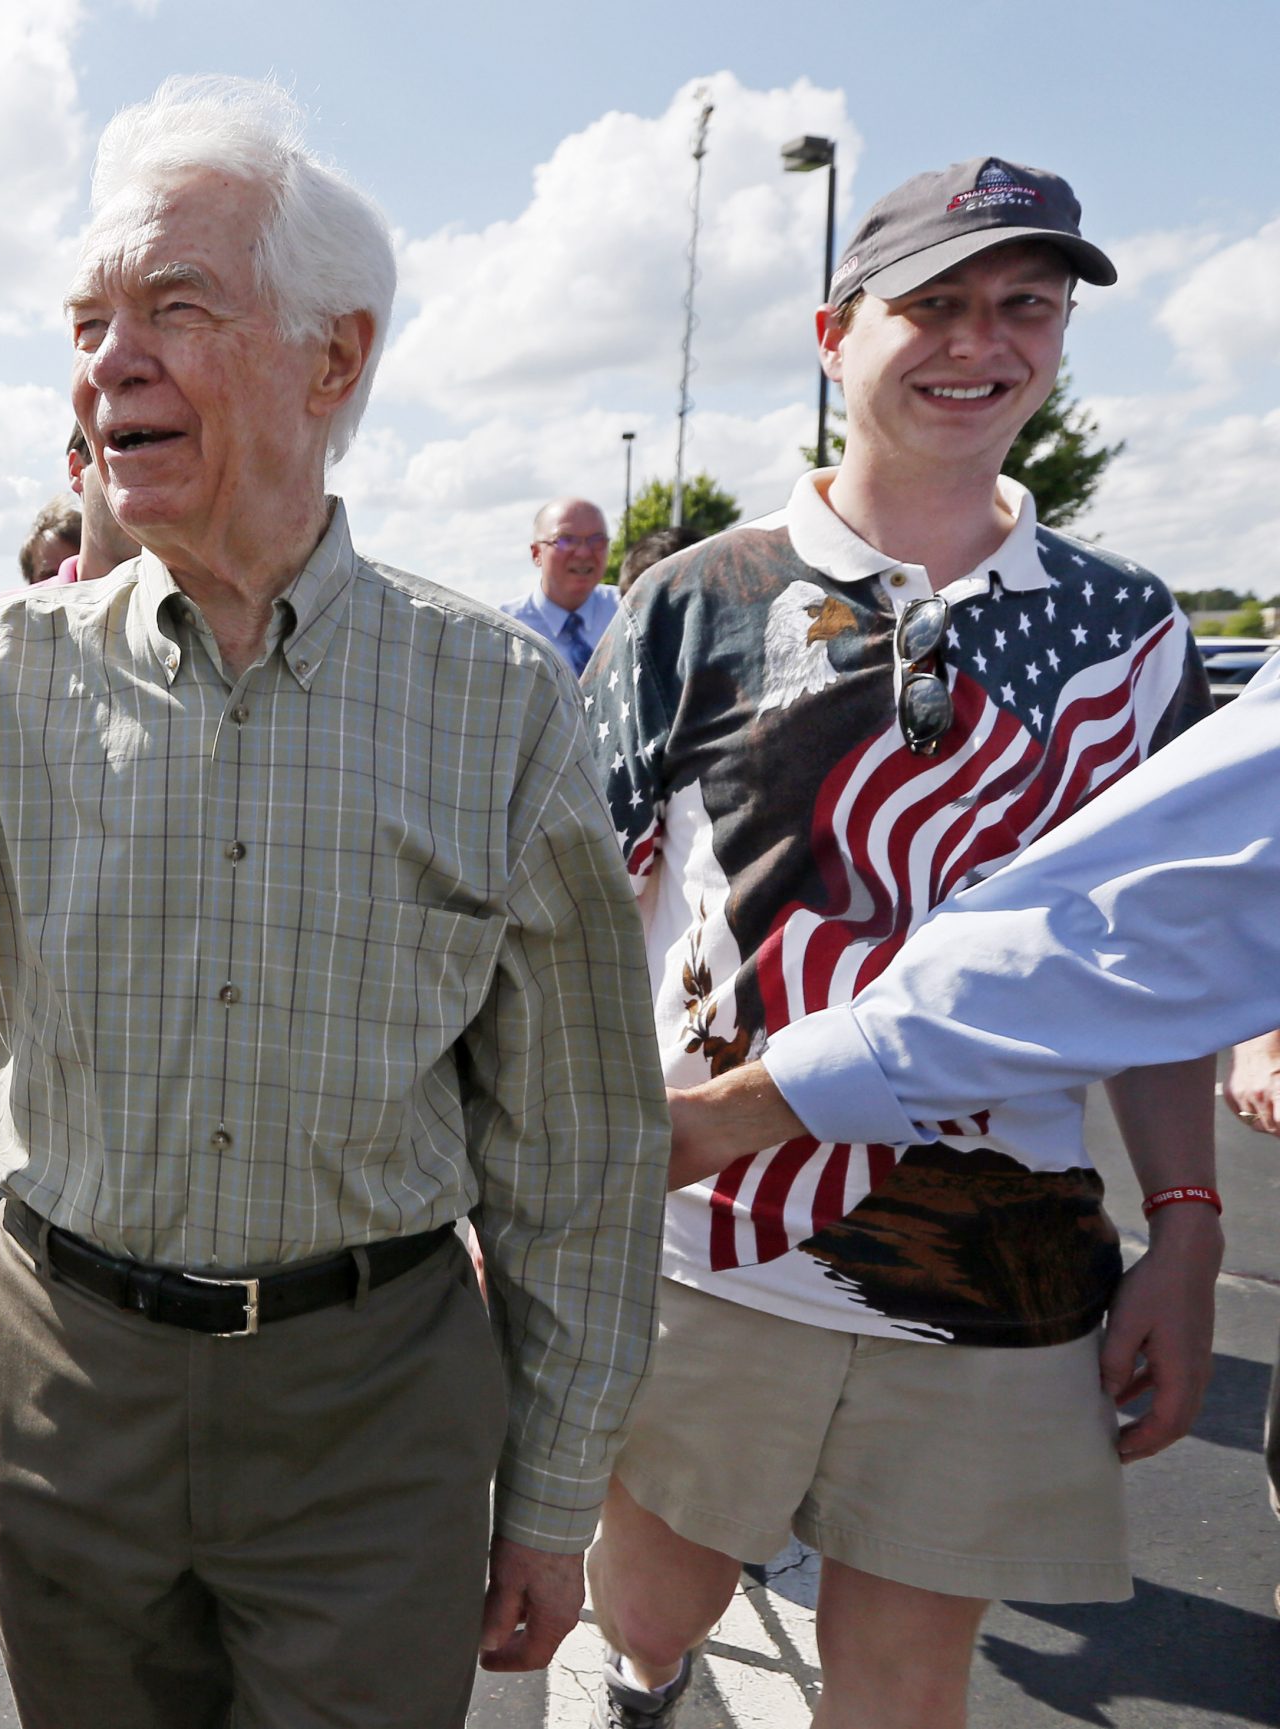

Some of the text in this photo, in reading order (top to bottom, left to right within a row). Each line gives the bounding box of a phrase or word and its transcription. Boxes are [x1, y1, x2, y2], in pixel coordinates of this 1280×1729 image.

[957, 189, 986, 201] THAD
[965, 198, 1033, 211] CLASSIC
[1186, 1189, 1211, 1199] The
